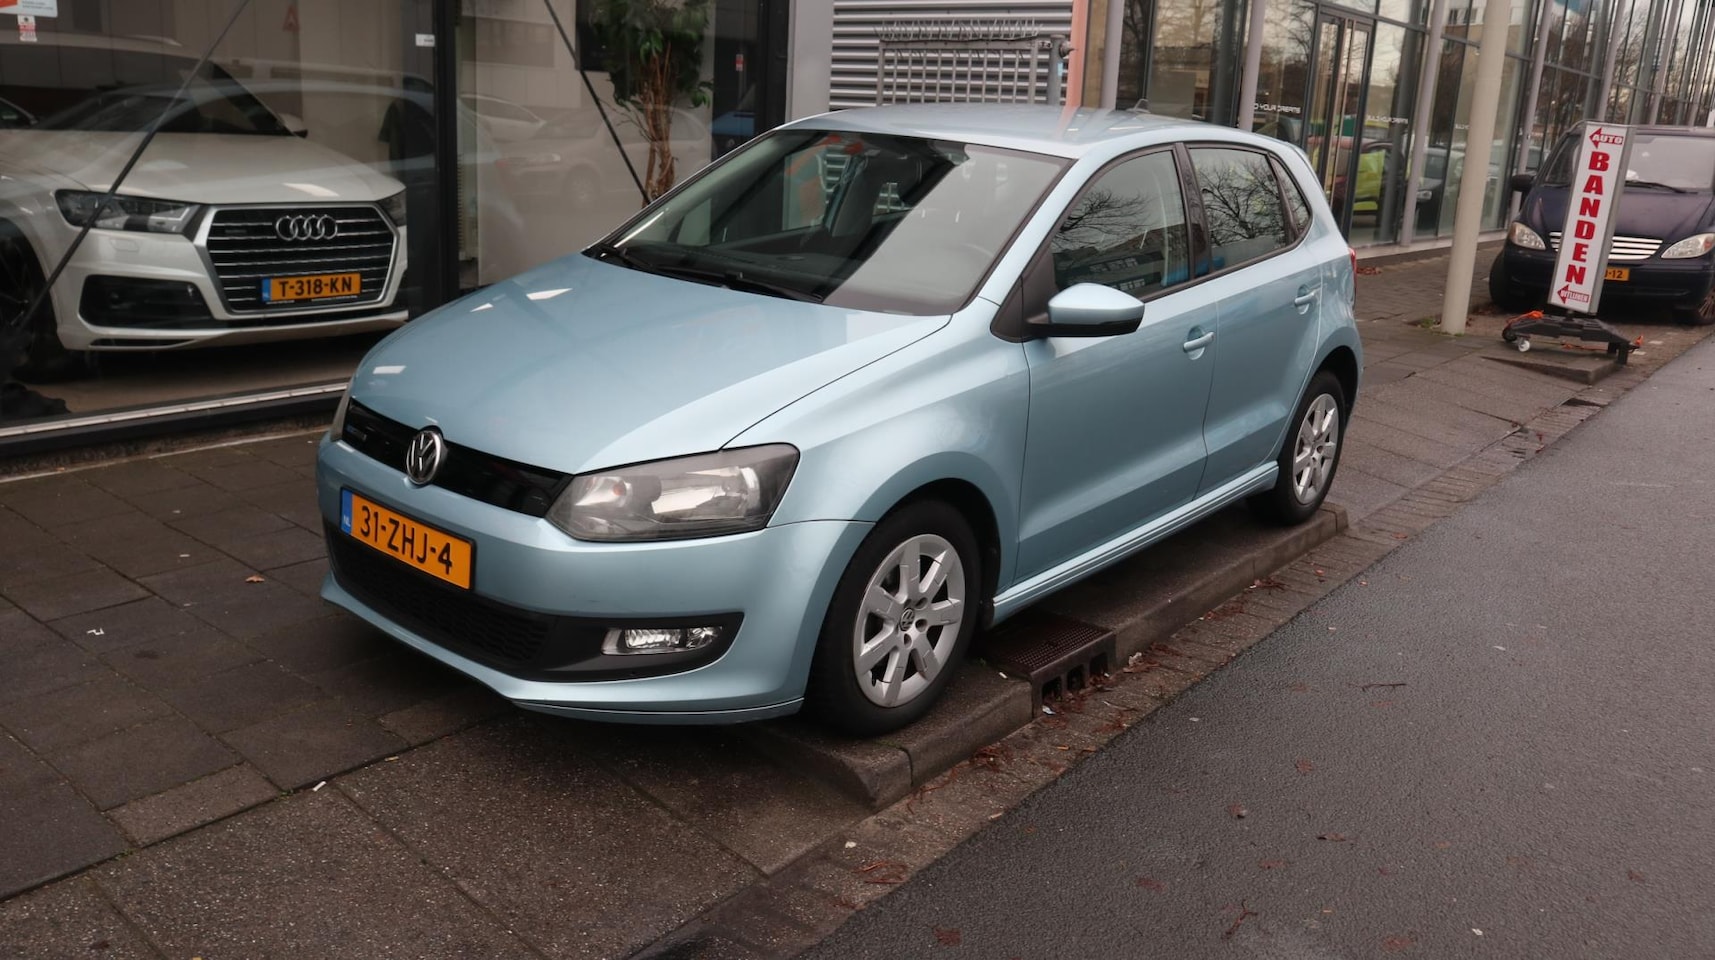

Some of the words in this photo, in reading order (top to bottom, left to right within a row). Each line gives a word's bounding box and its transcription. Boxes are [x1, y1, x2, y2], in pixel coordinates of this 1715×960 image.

[1592, 134, 1623, 145] AUTO
[1565, 151, 1610, 285] BANDEN
[278, 276, 352, 297] T-318-KN
[360, 505, 453, 575] 31-ZHJ-4
